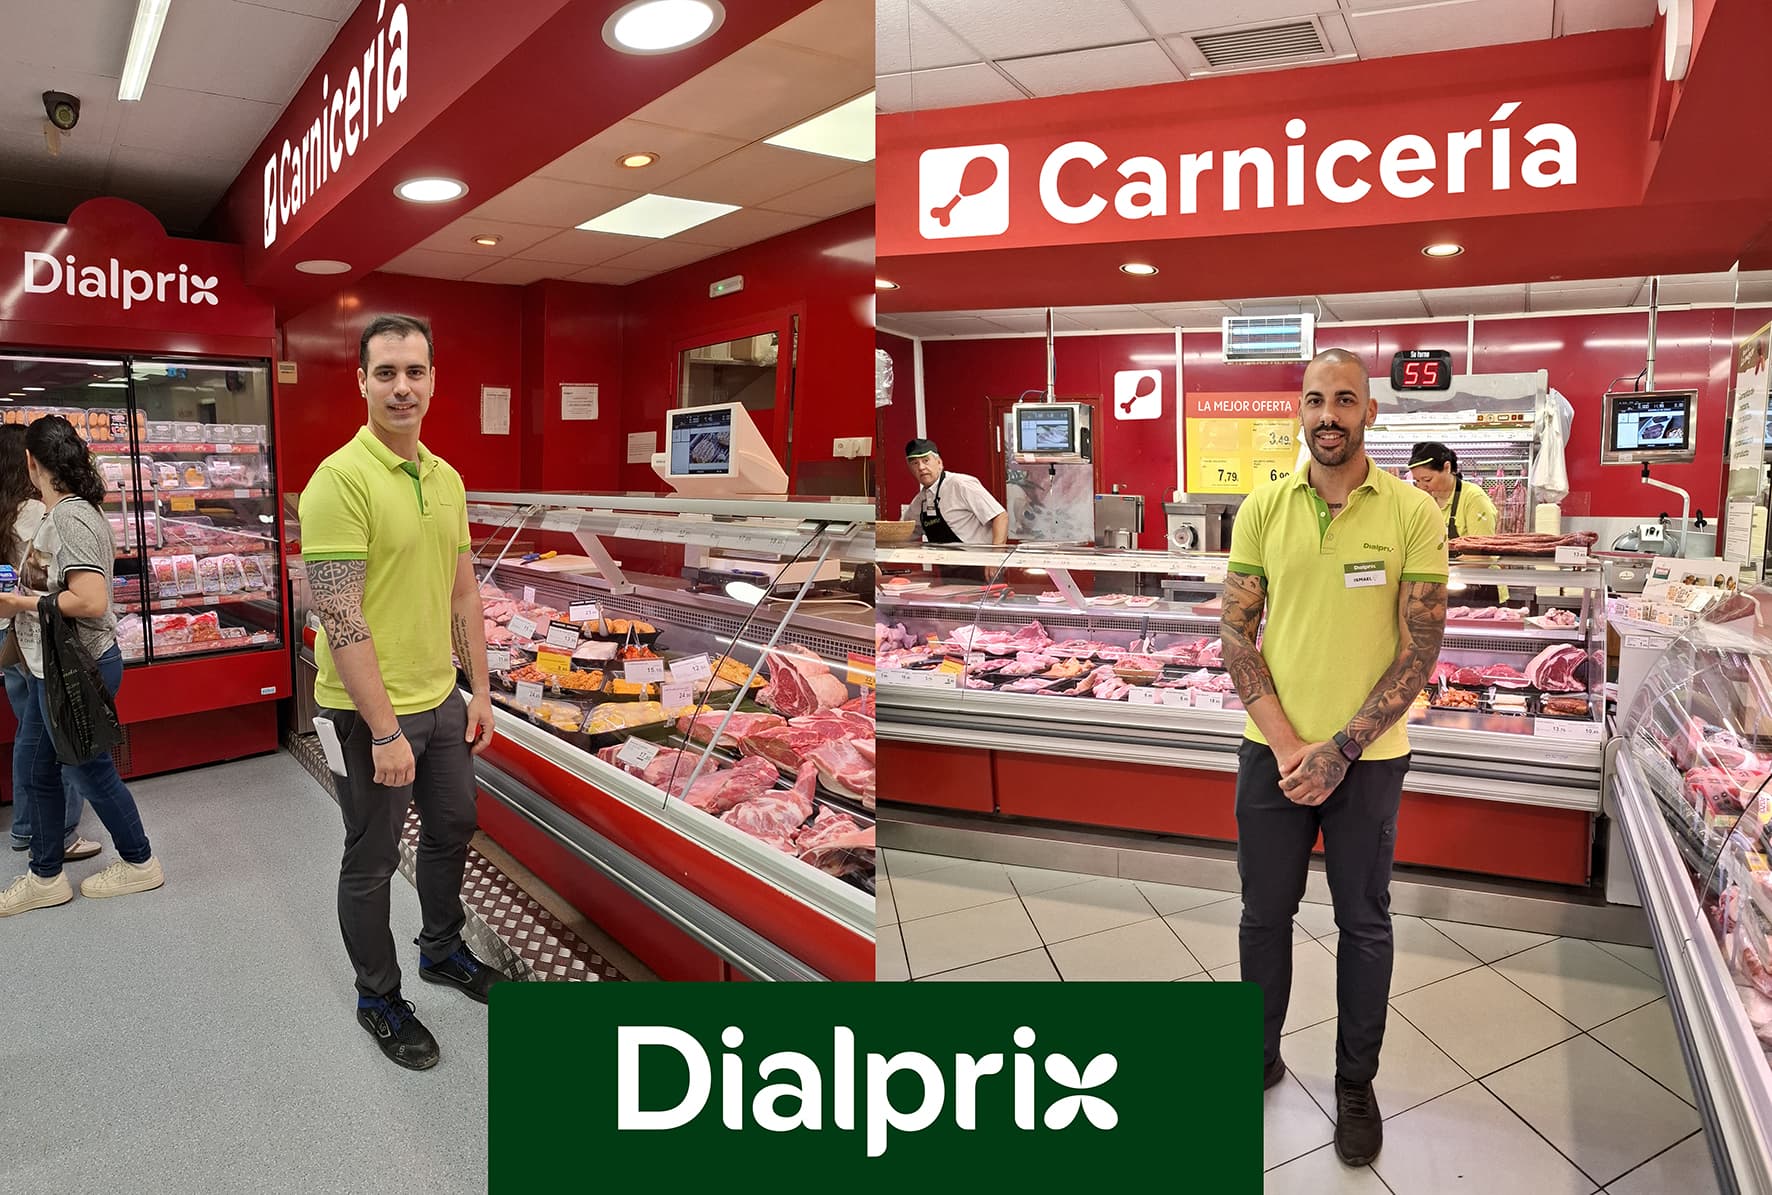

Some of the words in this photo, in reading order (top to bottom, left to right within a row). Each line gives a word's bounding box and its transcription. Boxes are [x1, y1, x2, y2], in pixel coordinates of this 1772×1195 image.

[280, 0, 408, 225] Carnicería
[1039, 101, 1577, 225] Carnicería
[24, 251, 219, 310] Dialprix
[1403, 362, 1439, 384] 55
[1197, 400, 1212, 412] LA
[1213, 400, 1250, 412] MEJOR
[1251, 400, 1293, 412] OFERTA
